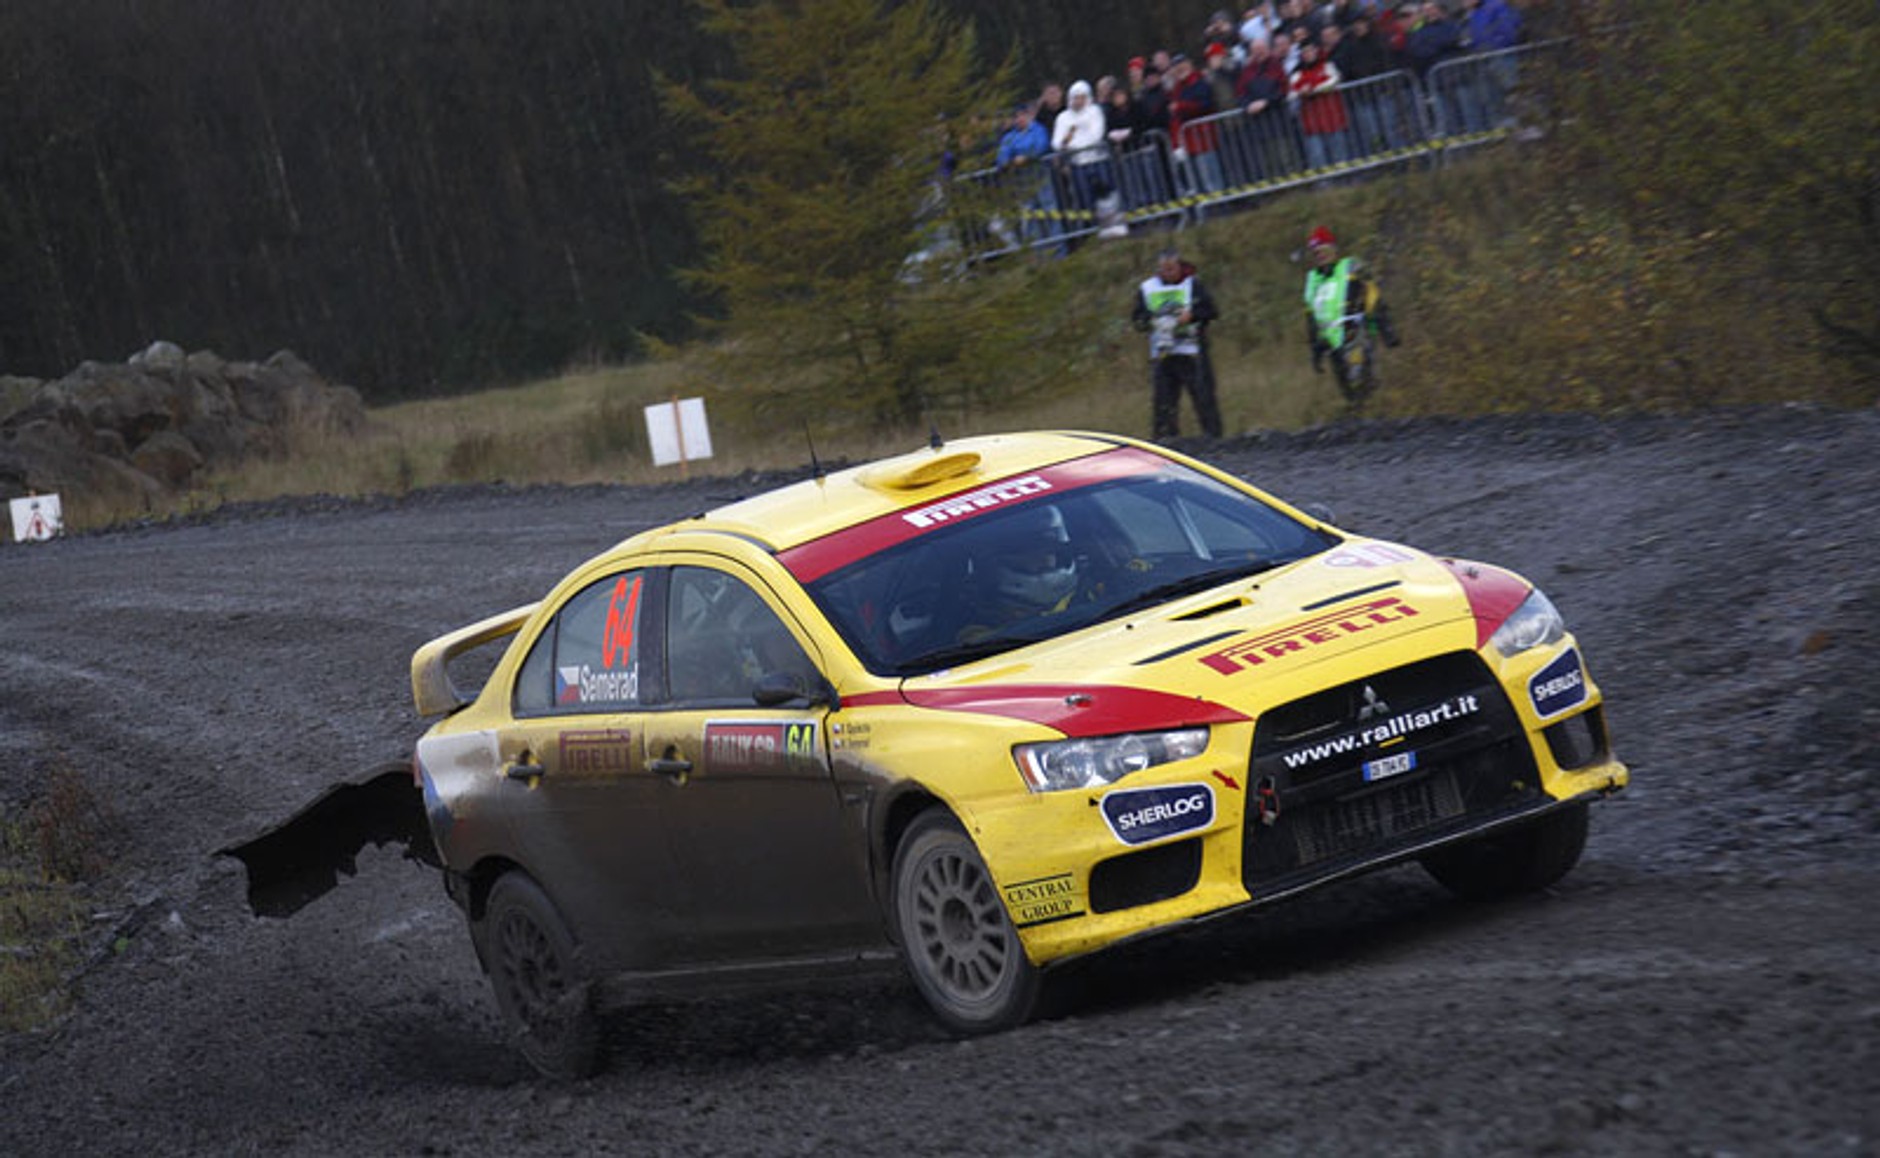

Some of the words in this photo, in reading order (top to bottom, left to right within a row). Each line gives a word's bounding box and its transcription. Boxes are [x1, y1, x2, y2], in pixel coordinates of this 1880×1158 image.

[902, 475, 1051, 528] PIRELLI
[602, 576, 642, 669] 64
[1198, 597, 1419, 676] PIRELLI
[580, 662, 639, 703] Semerad
[559, 729, 631, 771] PIRELLI
[1283, 695, 1478, 769] www.ralliart.it
[1118, 795, 1204, 830] SHERLOG
[1007, 879, 1073, 904] CENTRAL
[1021, 900, 1073, 919] GROUP
